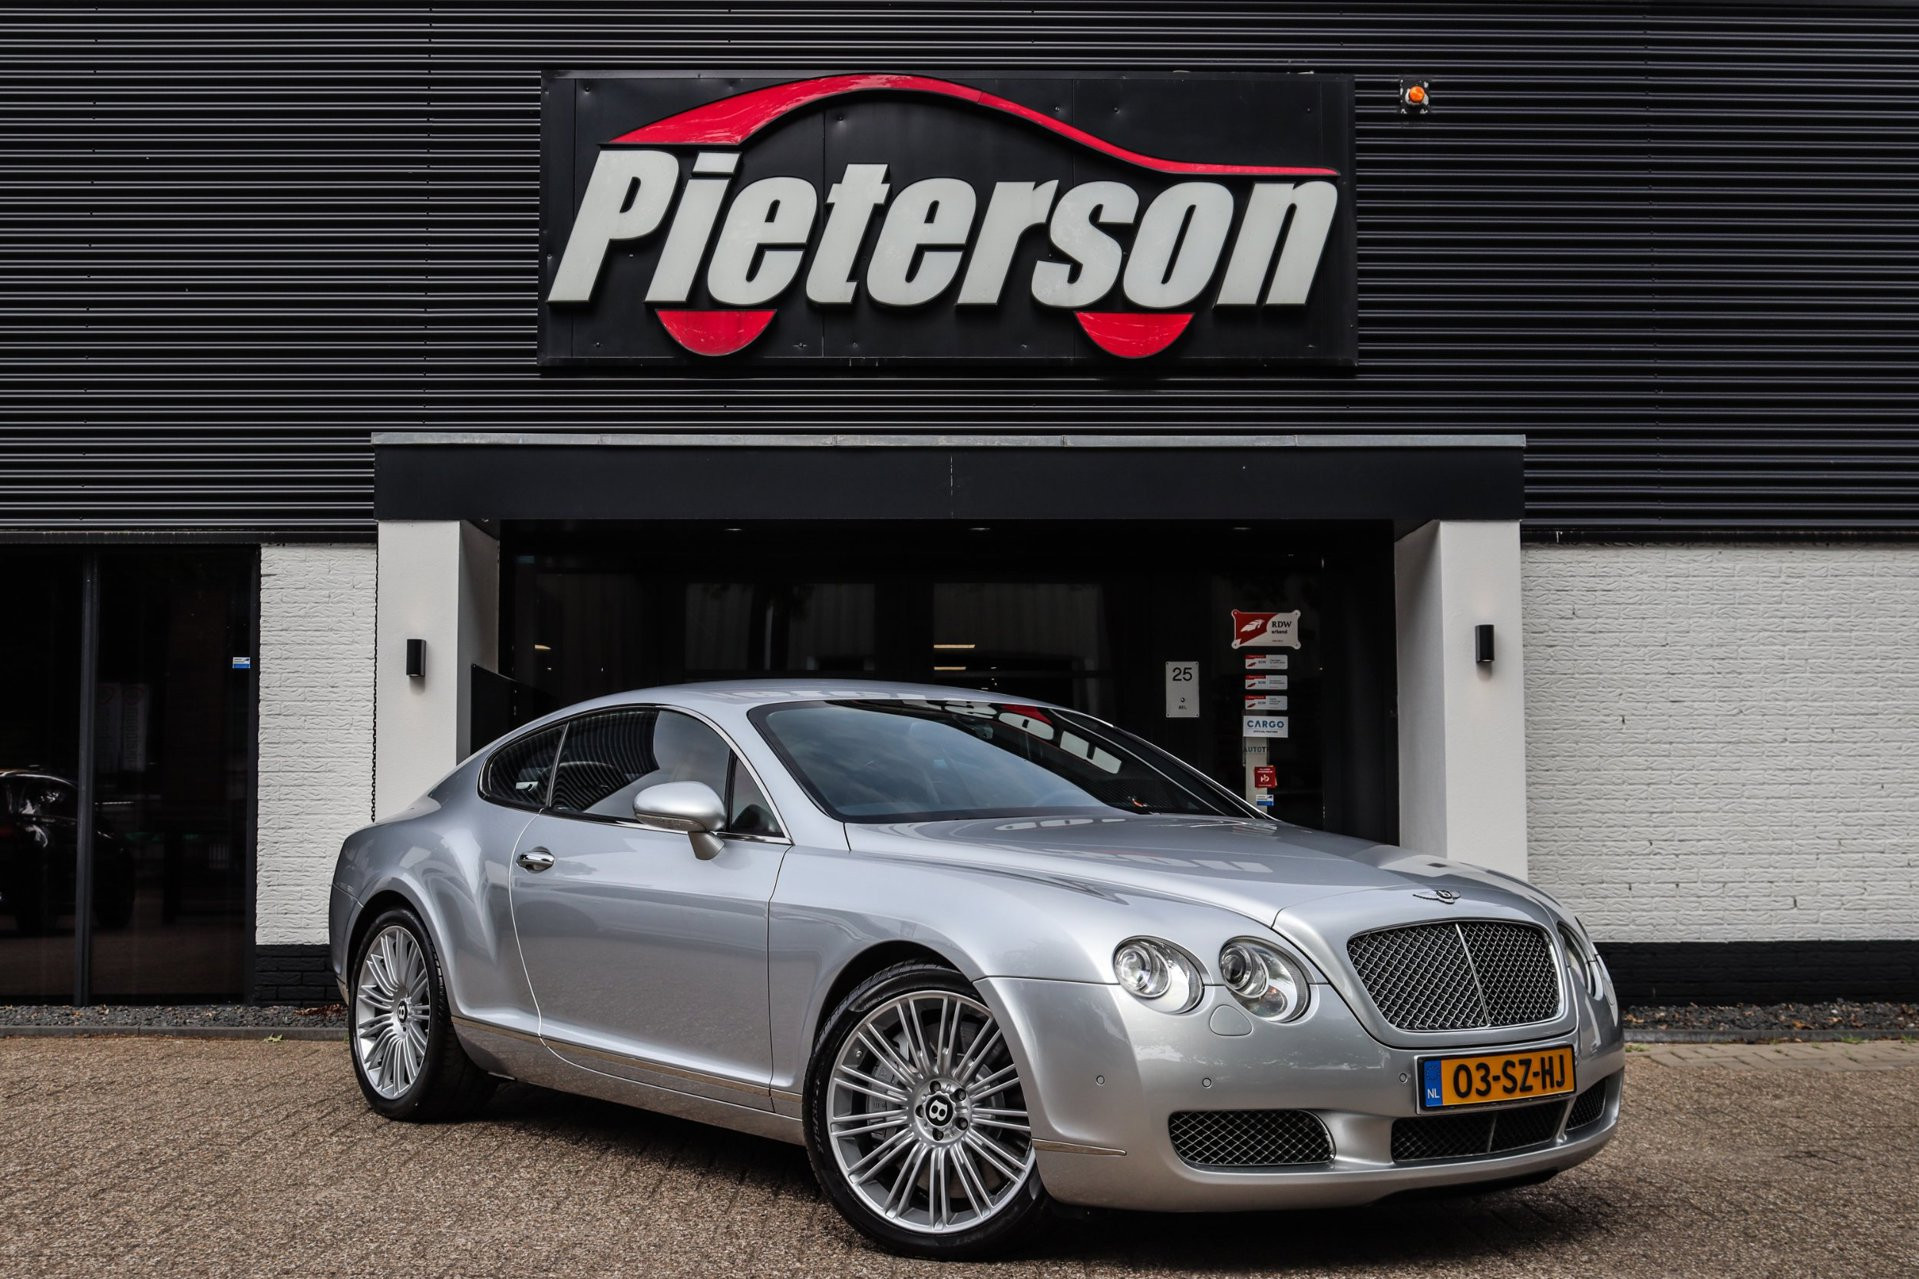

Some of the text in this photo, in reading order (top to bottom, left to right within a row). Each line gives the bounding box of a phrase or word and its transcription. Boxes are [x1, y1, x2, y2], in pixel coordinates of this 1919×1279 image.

[547, 149, 1340, 308] Pieterson
[1271, 620, 1292, 628] RDW
[1172, 666, 1193, 682] 25
[1246, 719, 1285, 729] CARGO
[1453, 1054, 1566, 1099] 03-SZ-HJ
[1427, 1088, 1440, 1099] NL
